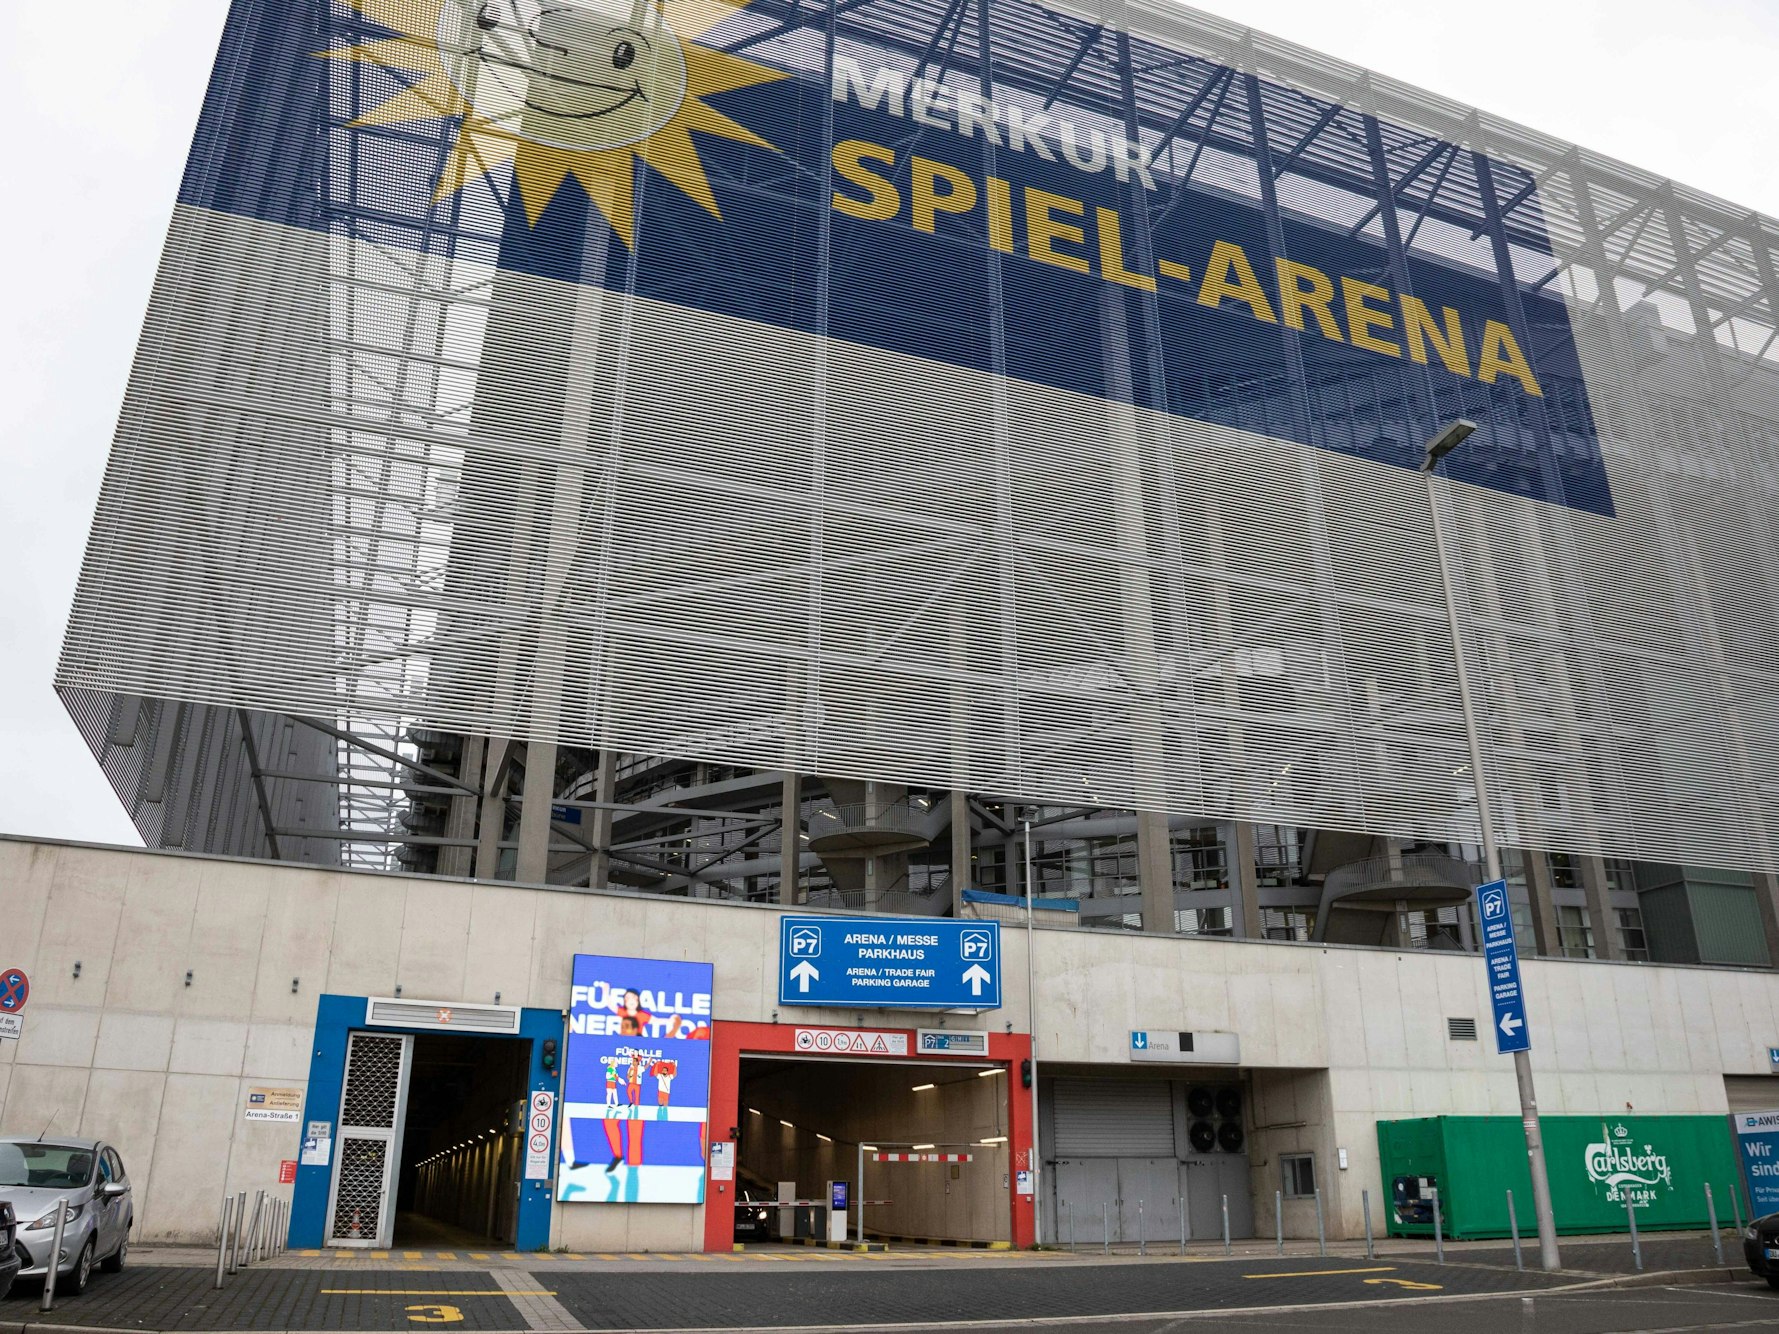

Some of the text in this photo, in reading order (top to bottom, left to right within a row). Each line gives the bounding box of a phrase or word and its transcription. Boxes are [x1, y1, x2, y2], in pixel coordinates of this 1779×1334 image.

[830, 55, 1156, 190] MERKUR
[831, 139, 1544, 398] SPIEL-ARENA
[1485, 900, 1501, 917] P7
[1487, 924, 1503, 932] ARENA
[1489, 930, 1506, 938] MESSE
[844, 934, 939, 946] ARENA / MESSE
[1486, 938, 1512, 948] PARKHAUS
[793, 939, 818, 954] P7
[963, 942, 988, 957] P7
[858, 948, 925, 960] PARKHAUS
[1491, 957, 1508, 965] ARENA
[846, 968, 877, 976] ARENA
[884, 968, 914, 977] TRADE
[915, 969, 935, 978] FAIR
[1494, 964, 1511, 972] TRADE
[851, 978, 930, 988] PARKING GARAGE
[1494, 983, 1517, 991] PARKING
[1496, 990, 1517, 999] GARAGE
[639, 989, 711, 1015] ALLE
[820, 1036, 829, 1046] 10
[925, 1039, 936, 1049] P7
[943, 1039, 949, 1048] 2
[1149, 1041, 1168, 1050] Arena
[638, 1048, 663, 1058] ALLE
[271, 1091, 301, 1099] Anmeldung
[246, 1111, 293, 1120] Arena-Straße
[536, 1118, 546, 1128] 10
[1744, 1141, 1772, 1157] Wir
[1585, 1142, 1667, 1185] Carlsberg
[404, 1304, 464, 1323] 3
